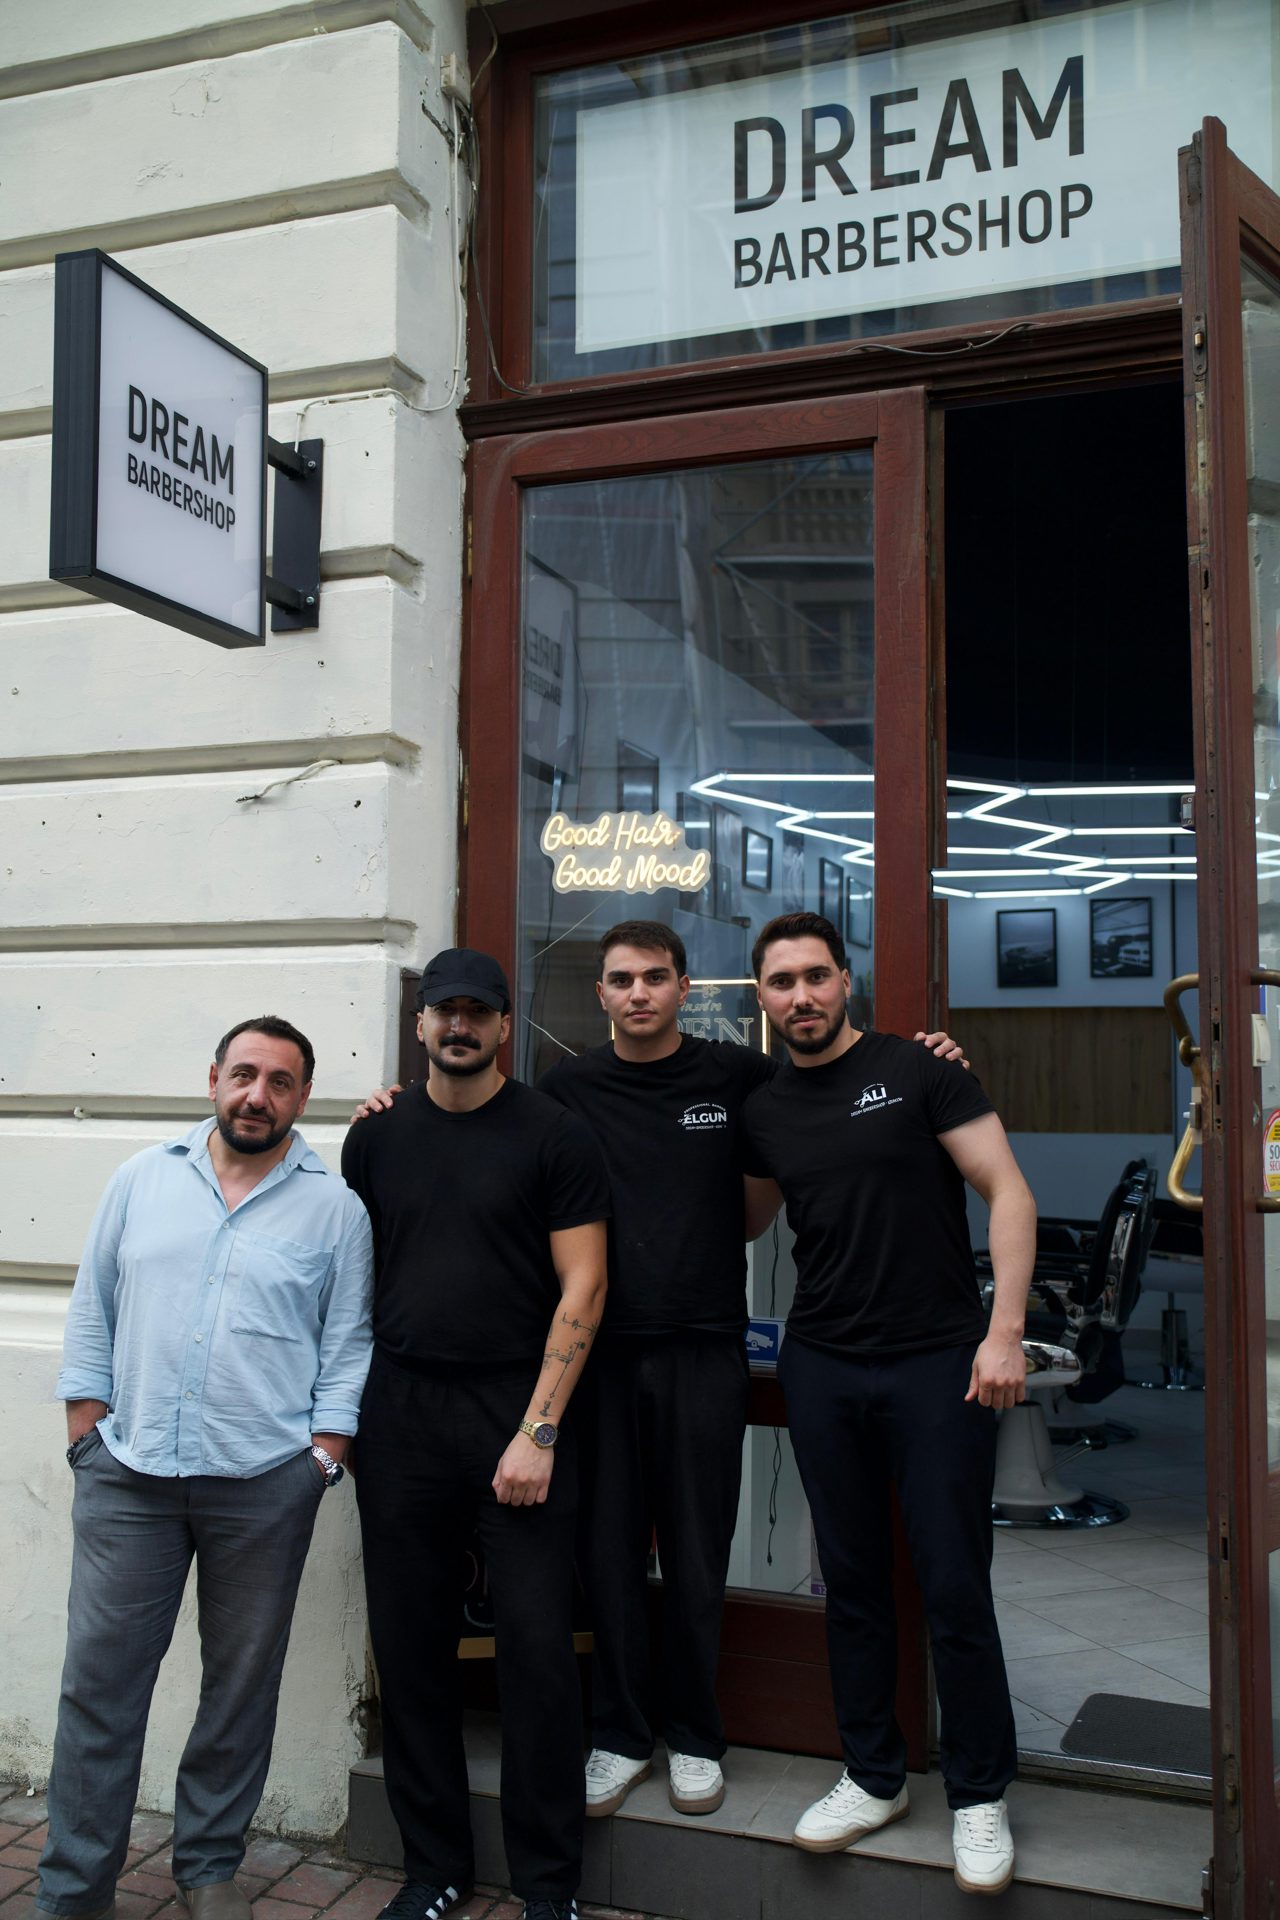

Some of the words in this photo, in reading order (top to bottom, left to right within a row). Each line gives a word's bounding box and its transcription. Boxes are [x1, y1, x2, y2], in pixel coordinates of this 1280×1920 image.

[734, 54, 1085, 214] DREAM
[734, 183, 1094, 289] BARBERSHOP
[128, 384, 235, 495] DREAM
[127, 453, 236, 533] BARBERSHOP
[543, 814, 609, 851] Good
[612, 813, 681, 850] Hair
[556, 854, 622, 888] Good
[626, 852, 707, 889] Mood
[676, 1017, 755, 1047] EN
[861, 1086, 887, 1102] ALI
[683, 1112, 727, 1124] ELGUN
